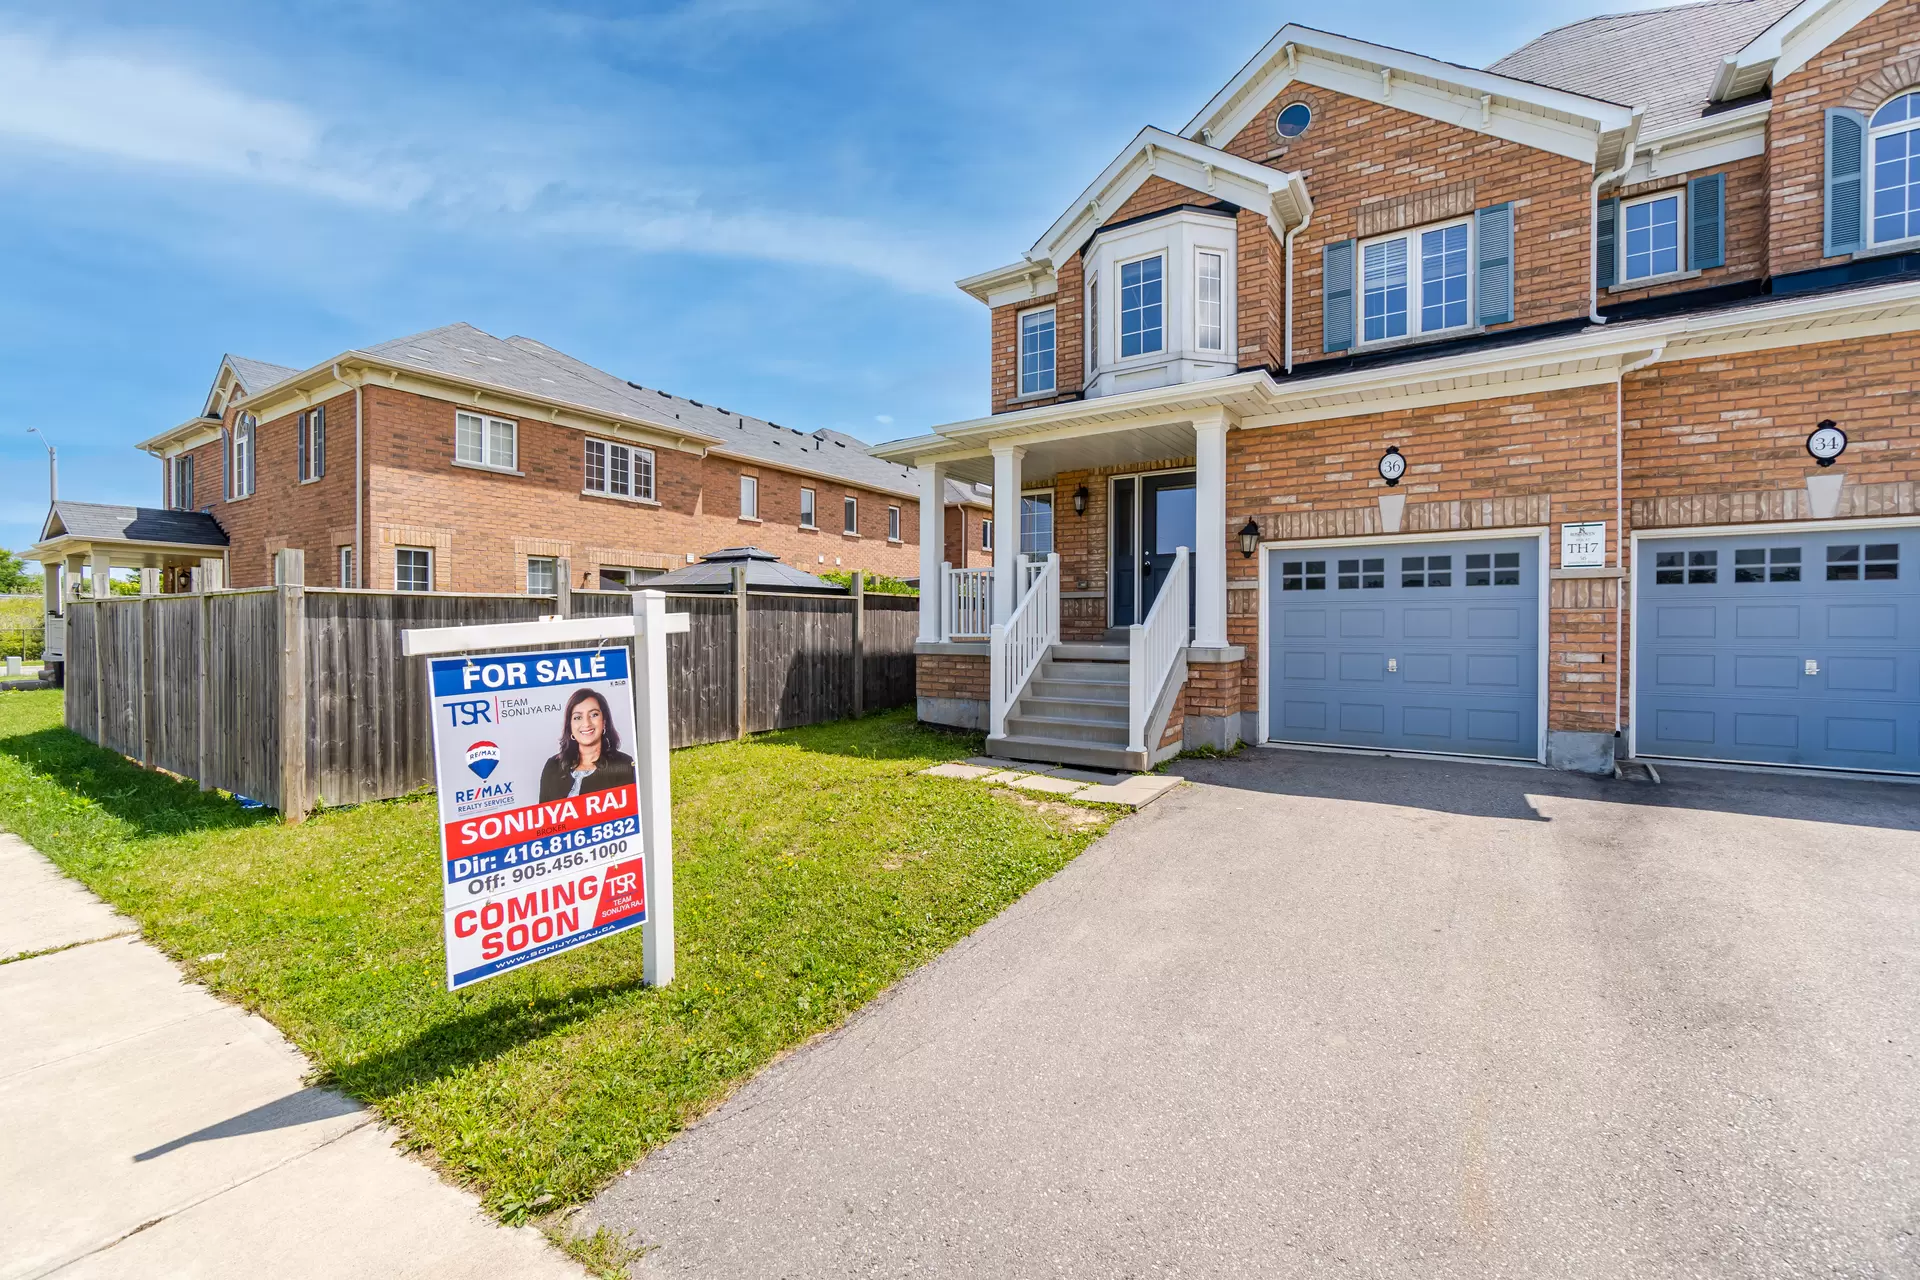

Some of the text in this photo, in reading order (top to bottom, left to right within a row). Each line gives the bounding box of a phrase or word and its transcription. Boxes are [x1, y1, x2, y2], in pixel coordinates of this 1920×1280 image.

[1815, 437, 1839, 451] 34
[1384, 460, 1401, 473] 36
[1567, 543, 1599, 553] TH7
[462, 656, 607, 690] FOR SALE
[443, 699, 492, 727] TSR
[500, 698, 528, 709] TEAM
[501, 703, 562, 718] SONIJYA RAJ
[469, 750, 497, 760] RE/MAX
[455, 782, 513, 803] RE/MAX
[457, 802, 483, 813] REALTY
[484, 796, 515, 807] SERVICES
[460, 789, 627, 845] SONIJYA RAJ
[536, 823, 567, 837] BROKER
[454, 818, 636, 879] Dir: 416.816.5832
[468, 840, 628, 895] Off: 905.456.1000
[605, 872, 637, 896] TSR
[454, 875, 598, 939] COMING
[601, 898, 643, 918] SONIJYA RAJ
[613, 895, 632, 906] TEAM
[481, 907, 580, 961] SOON
